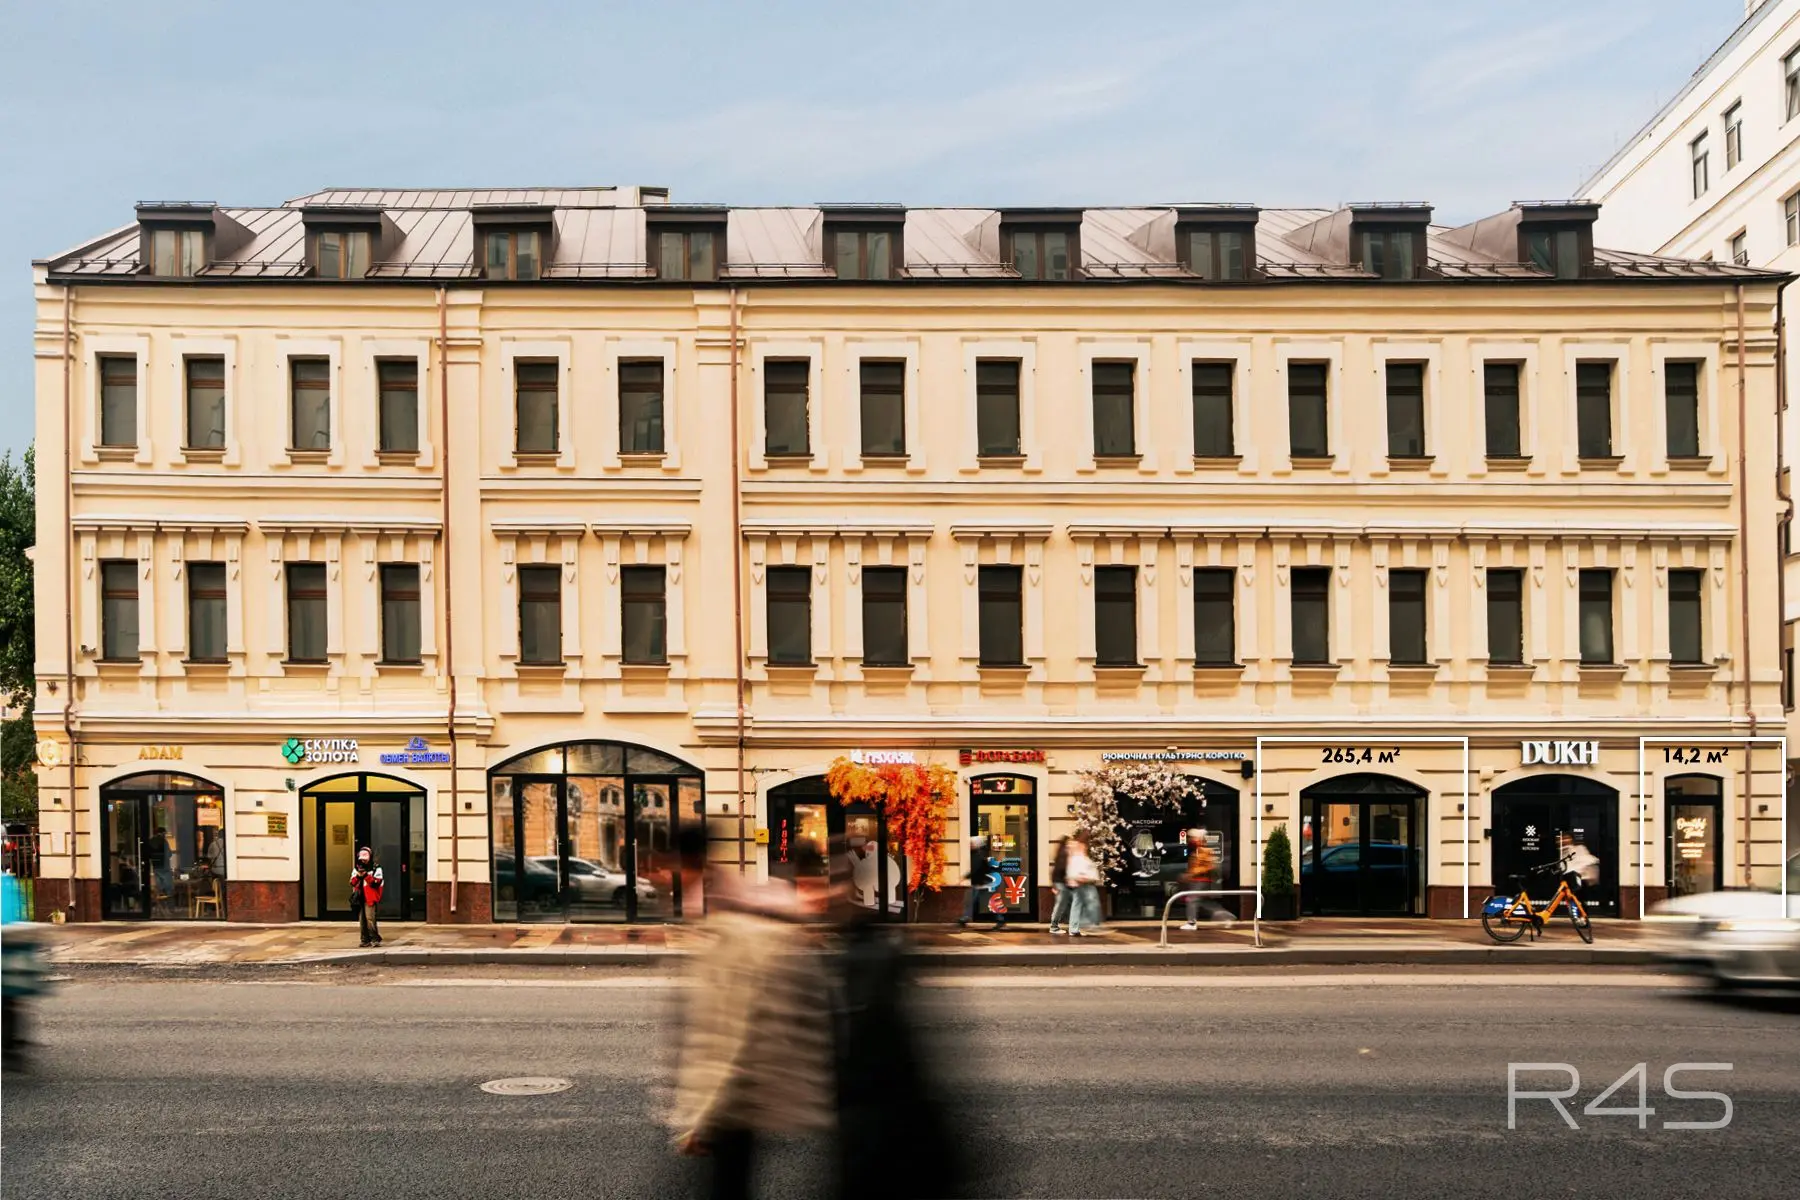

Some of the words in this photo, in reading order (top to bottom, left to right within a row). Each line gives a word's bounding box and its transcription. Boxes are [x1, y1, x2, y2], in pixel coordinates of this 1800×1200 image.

[305, 739, 358, 750] СКУПКА
[138, 745, 184, 760] ADAM
[305, 751, 359, 762] ЗОЛОТА
[1103, 752, 1153, 760] РЮМОЧНАЯ
[1155, 752, 1203, 760] КУЛЬТУРНО
[1521, 740, 1600, 764] DUKH
[411, 753, 450, 763] ВАЛЮТЫ
